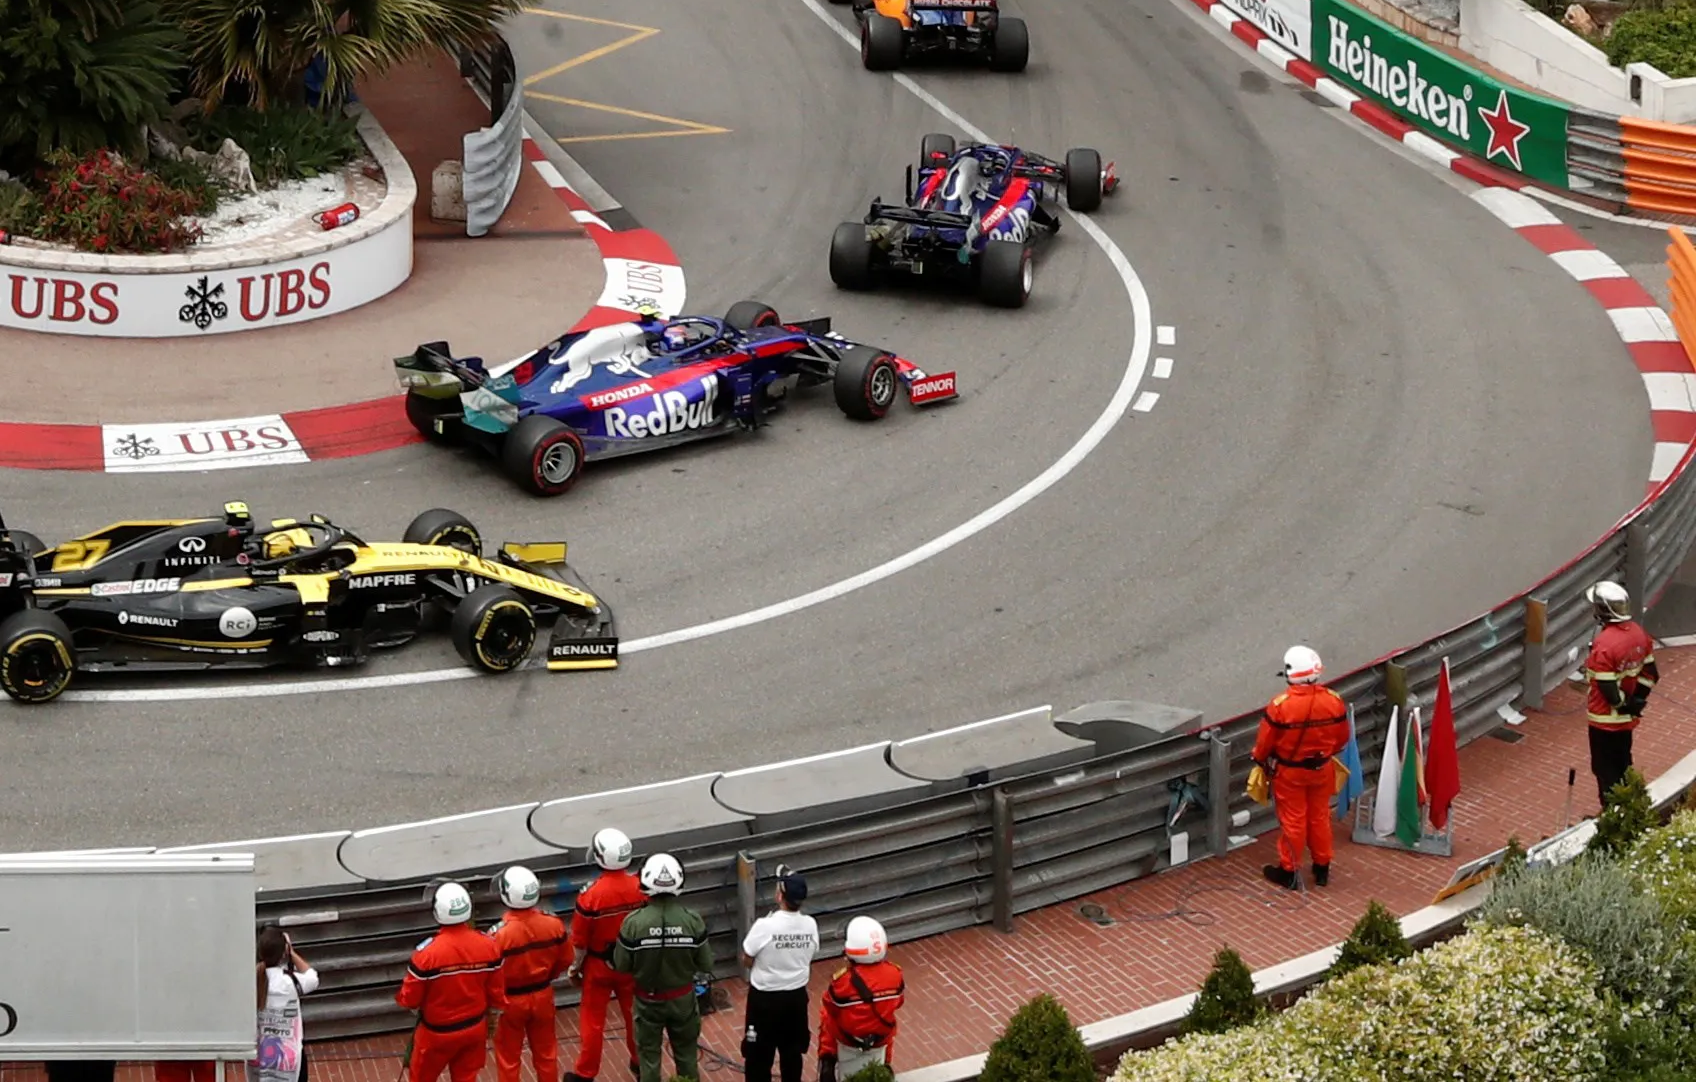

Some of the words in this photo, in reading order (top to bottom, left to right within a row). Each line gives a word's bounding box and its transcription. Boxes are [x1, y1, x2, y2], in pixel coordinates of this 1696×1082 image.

[1326, 14, 1471, 141] Heineken
[626, 261, 664, 294] UBS
[8, 275, 120, 325] UBS
[237, 261, 332, 321] UBS
[590, 382, 654, 407] HONDA
[911, 377, 954, 399] TENNOR
[177, 426, 291, 456] UBS
[52, 539, 112, 572] 27
[164, 555, 222, 567] INFINITI
[102, 582, 132, 594] Castrol
[132, 577, 181, 594] EDGE
[349, 573, 417, 589] MAPFRE
[130, 614, 179, 627] RENAULT
[553, 644, 616, 656] RENAULT
[775, 942, 811, 950] CIRCUIT
[263, 1027, 291, 1036] PHOTO
